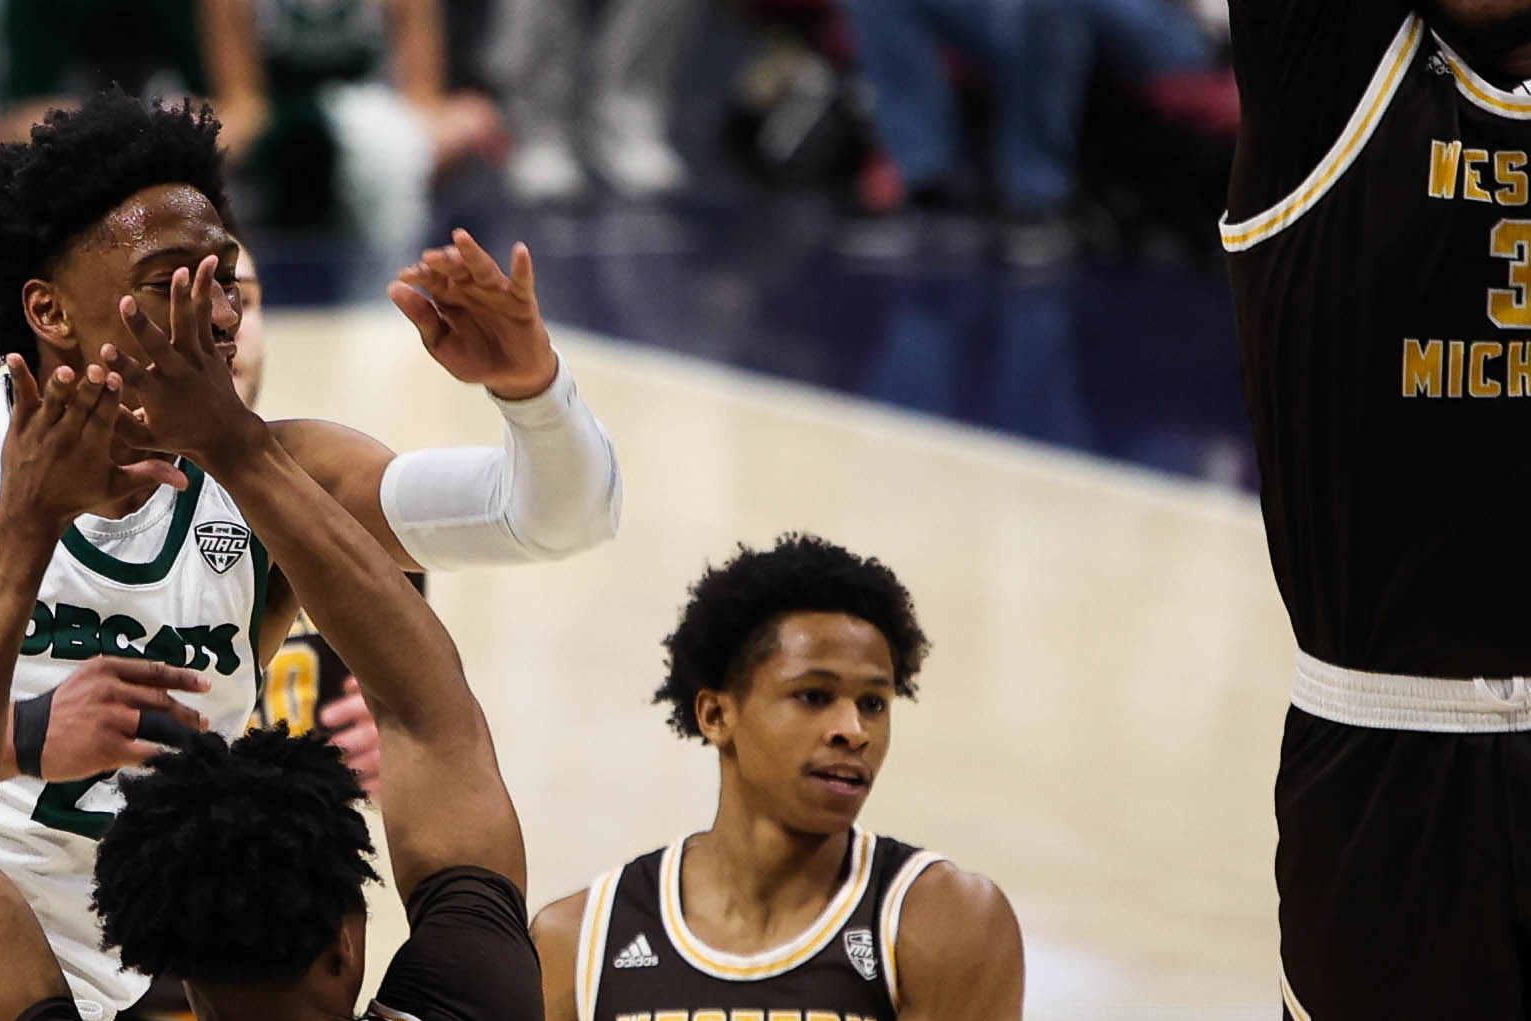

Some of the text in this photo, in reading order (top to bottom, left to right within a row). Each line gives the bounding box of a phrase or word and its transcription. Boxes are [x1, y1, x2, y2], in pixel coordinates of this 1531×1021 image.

[1428, 140, 1529, 206] WES
[1402, 338, 1531, 398] MICH
[199, 537, 246, 552] MAC
[19, 600, 240, 675] OBCATS
[613, 953, 659, 968] adidas
